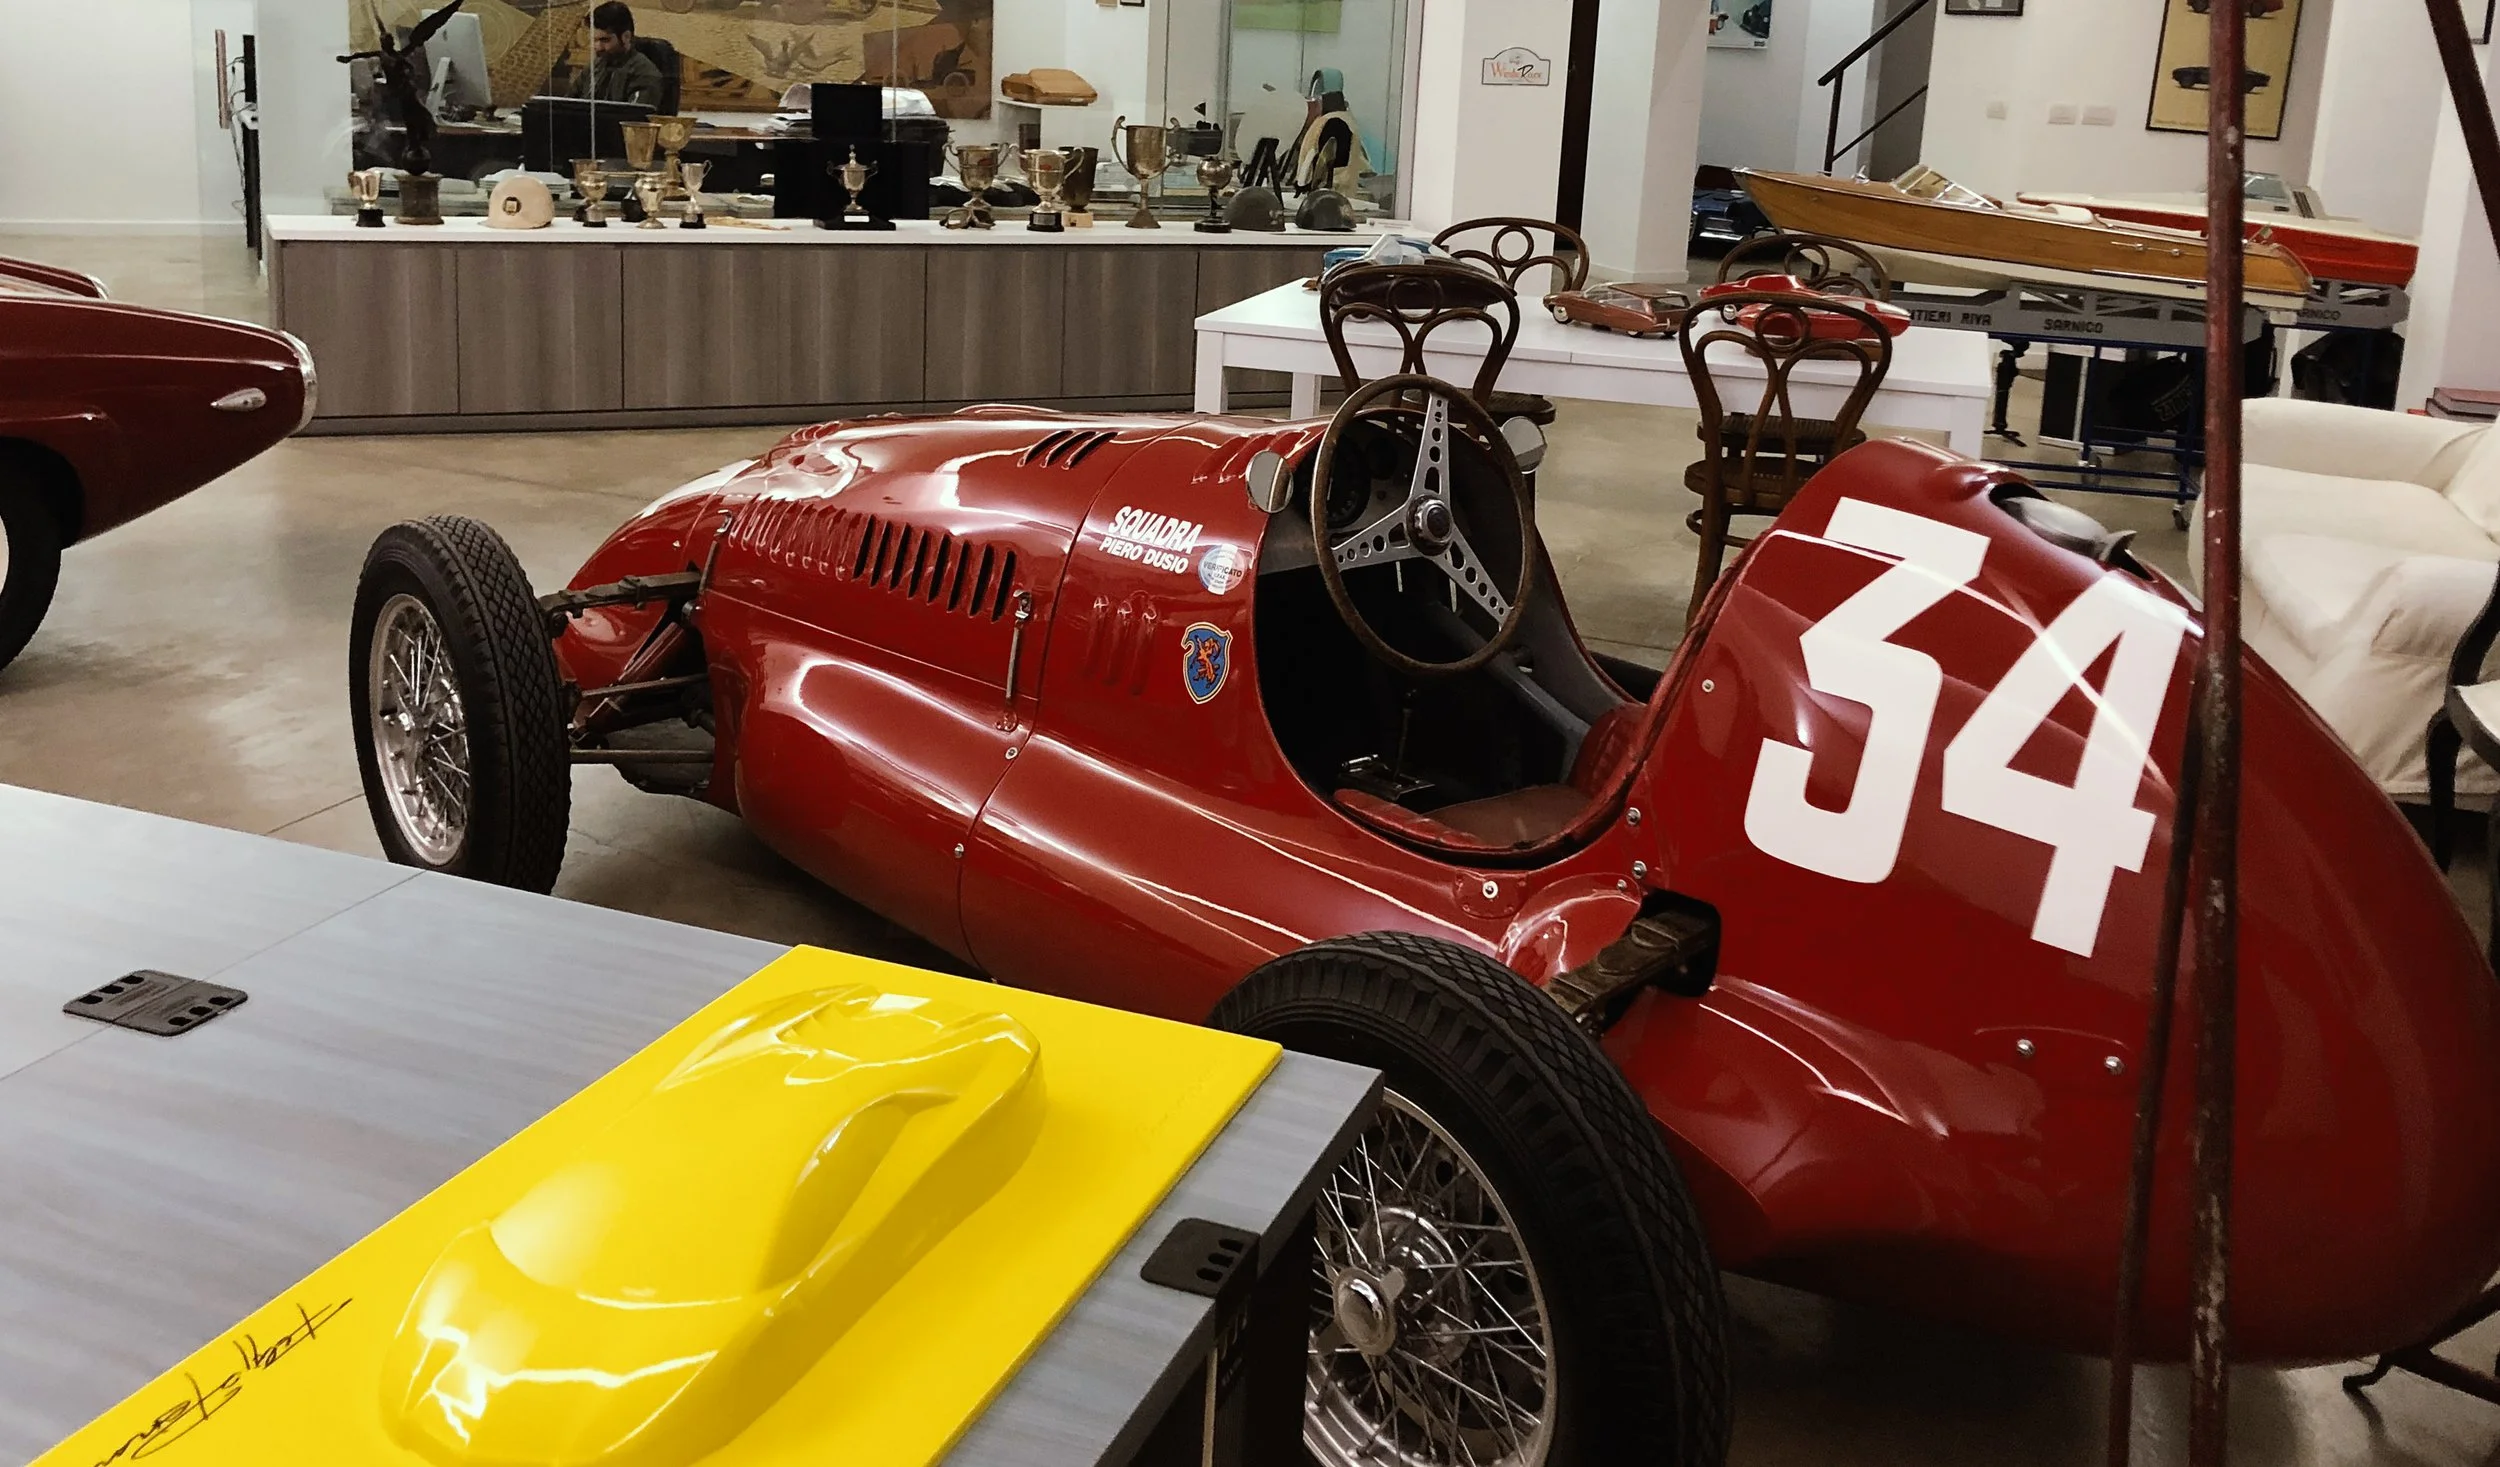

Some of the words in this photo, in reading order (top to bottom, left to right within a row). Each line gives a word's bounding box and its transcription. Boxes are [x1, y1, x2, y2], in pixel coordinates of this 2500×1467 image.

[1960, 313, 1992, 326] RIVA
[2043, 318, 2103, 334] SARNICO
[1109, 506, 1203, 554] SQUADRA
[1099, 537, 1143, 561] PIERO
[1142, 548, 1190, 574] DUSIO
[1744, 496, 2190, 958] 34
